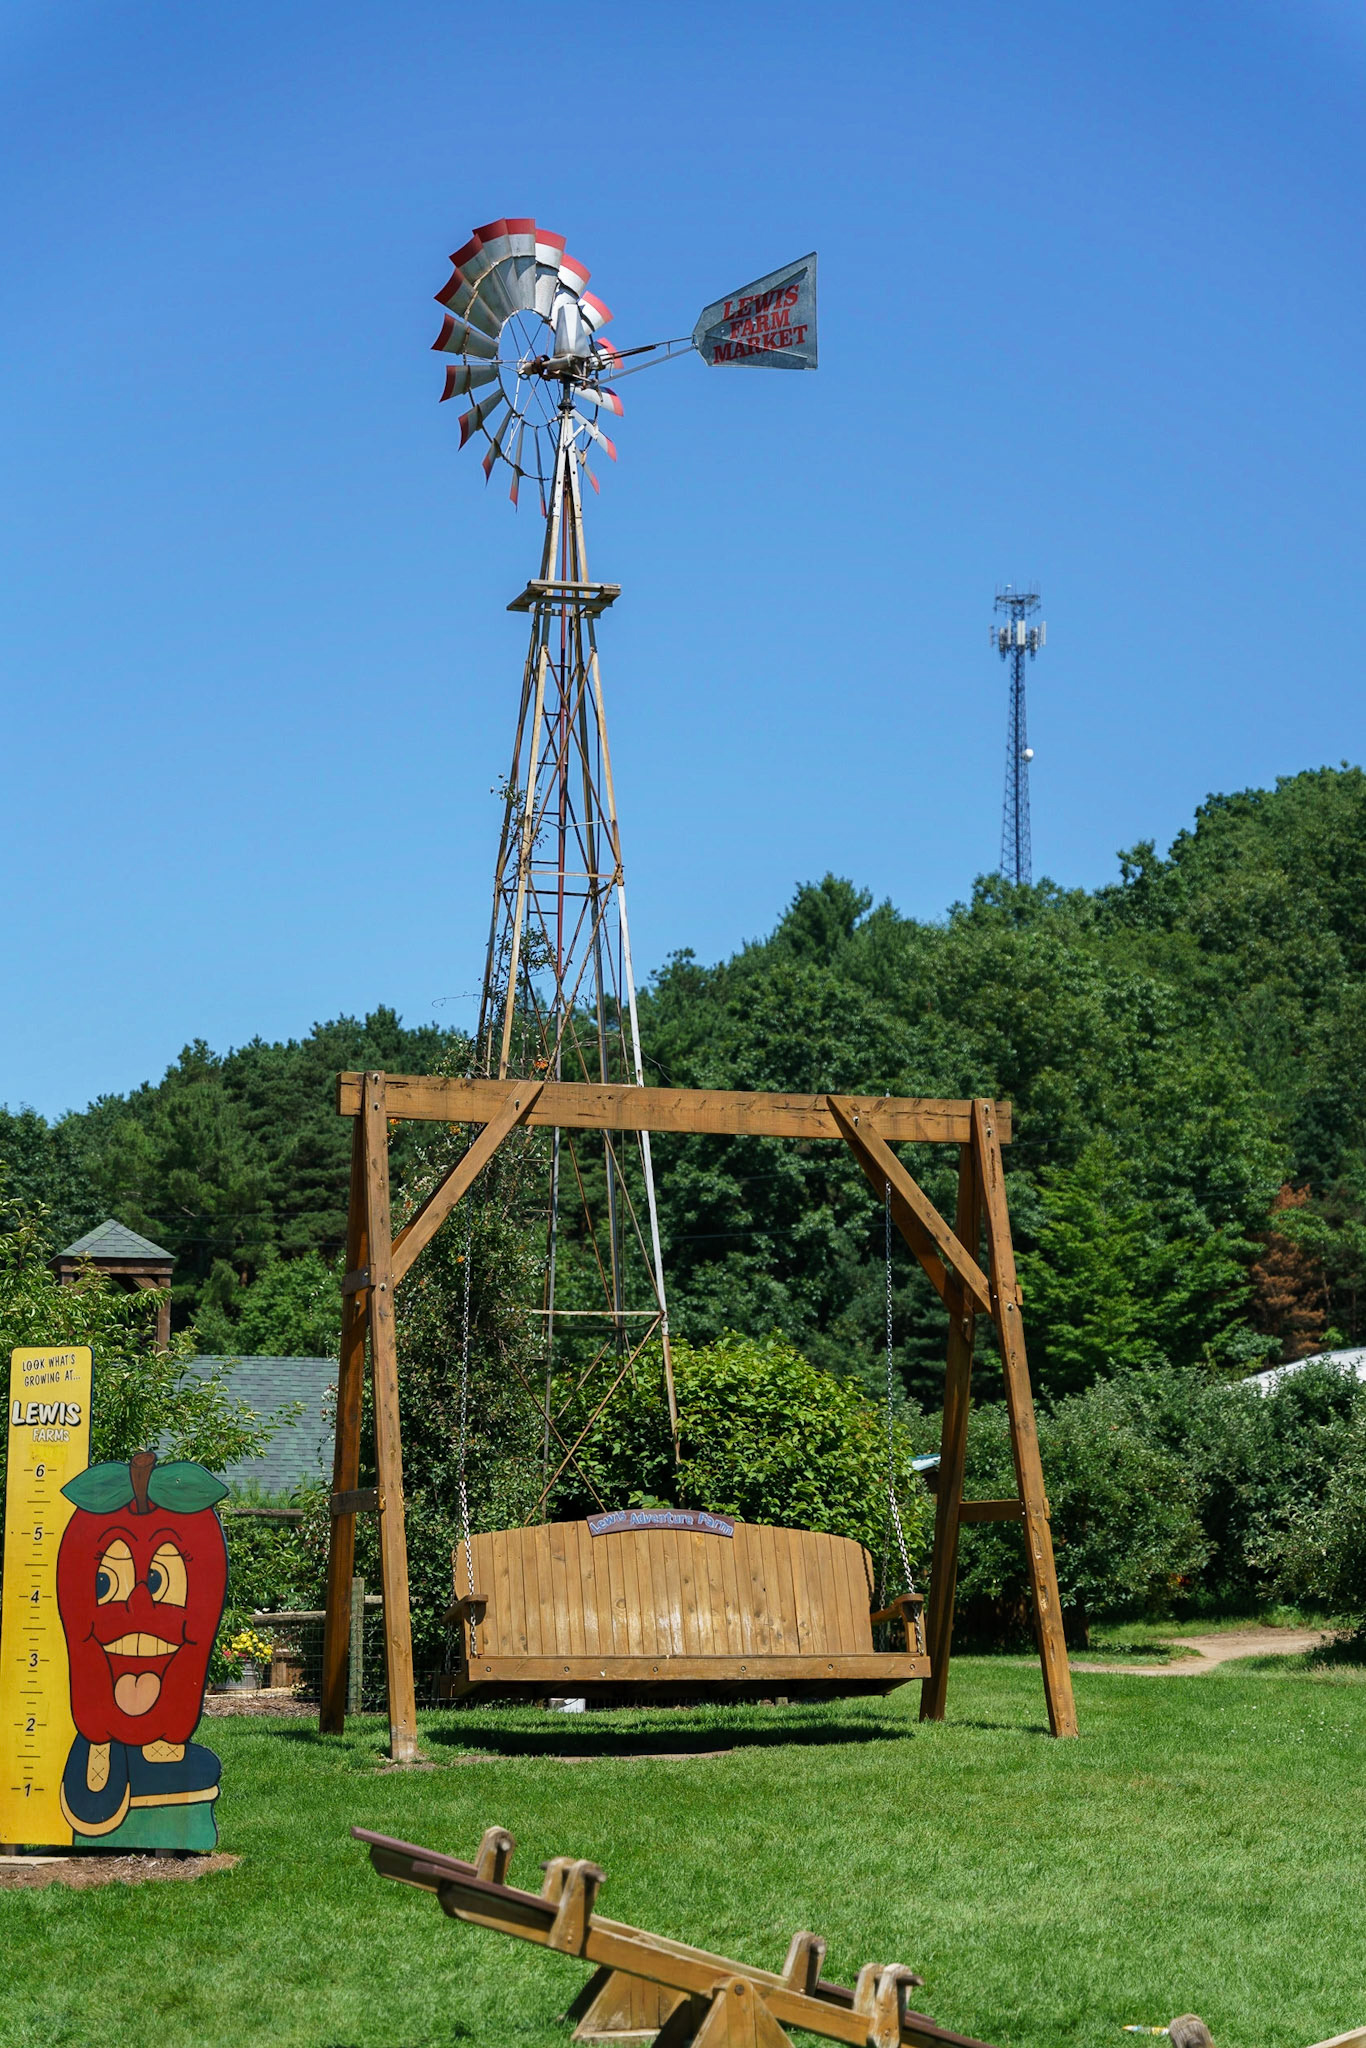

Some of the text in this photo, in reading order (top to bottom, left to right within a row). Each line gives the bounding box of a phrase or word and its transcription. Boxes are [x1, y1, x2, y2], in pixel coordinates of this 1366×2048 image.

[723, 285, 800, 321] LEWIS
[729, 308, 791, 340] FARM
[712, 324, 808, 364] MARKET
[22, 1354, 75, 1372] LOOK WHAT'S
[24, 1369, 81, 1387] GROWING AT...
[12, 1400, 81, 1426] LEWIS
[32, 1427, 70, 1442] FARMS
[36, 1464, 45, 1478] 6
[589, 1509, 734, 1536] Lewis Adventure Farm
[34, 1527, 43, 1541] 5
[30, 1590, 40, 1604] 4
[29, 1653, 39, 1667] 3
[25, 1718, 35, 1732] 2
[24, 1784, 31, 1797] 1
